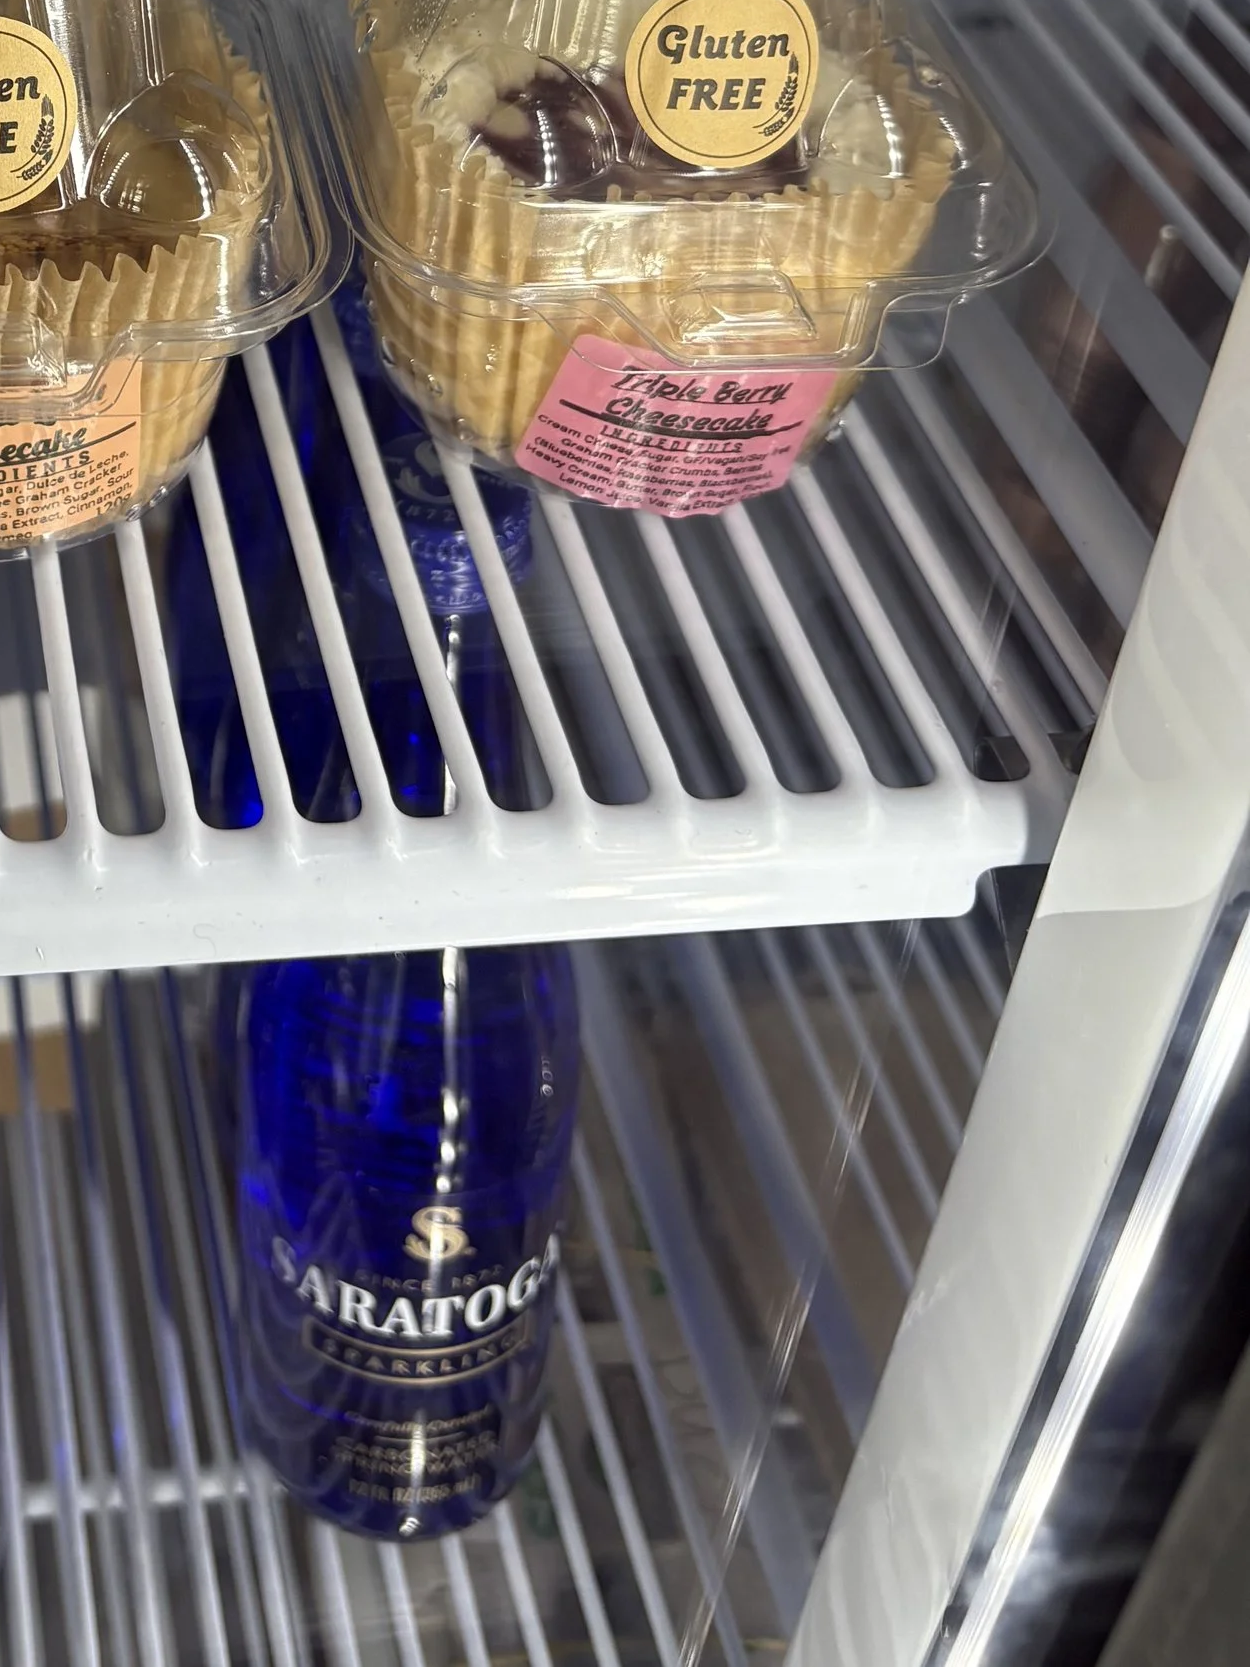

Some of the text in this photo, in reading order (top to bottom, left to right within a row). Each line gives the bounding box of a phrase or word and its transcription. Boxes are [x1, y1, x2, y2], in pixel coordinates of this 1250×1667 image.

[657, 24, 790, 65] Gluten
[666, 78, 767, 111] FREE
[615, 366, 794, 404] Triple Berry
[538, 414, 582, 437] Cream
[605, 396, 774, 431] Cheesecake
[526, 443, 565, 469] Heavy
[561, 438, 613, 461] Graham
[15, 486, 69, 505] Graham
[73, 462, 122, 489] Cracker
[16, 502, 60, 516] Brown
[107, 467, 134, 487] Sour
[27, 475, 65, 490] Dulce
[69, 470, 86, 480] de
[559, 472, 604, 495] Lemon
[271, 1232, 560, 1339] SARATOGA
